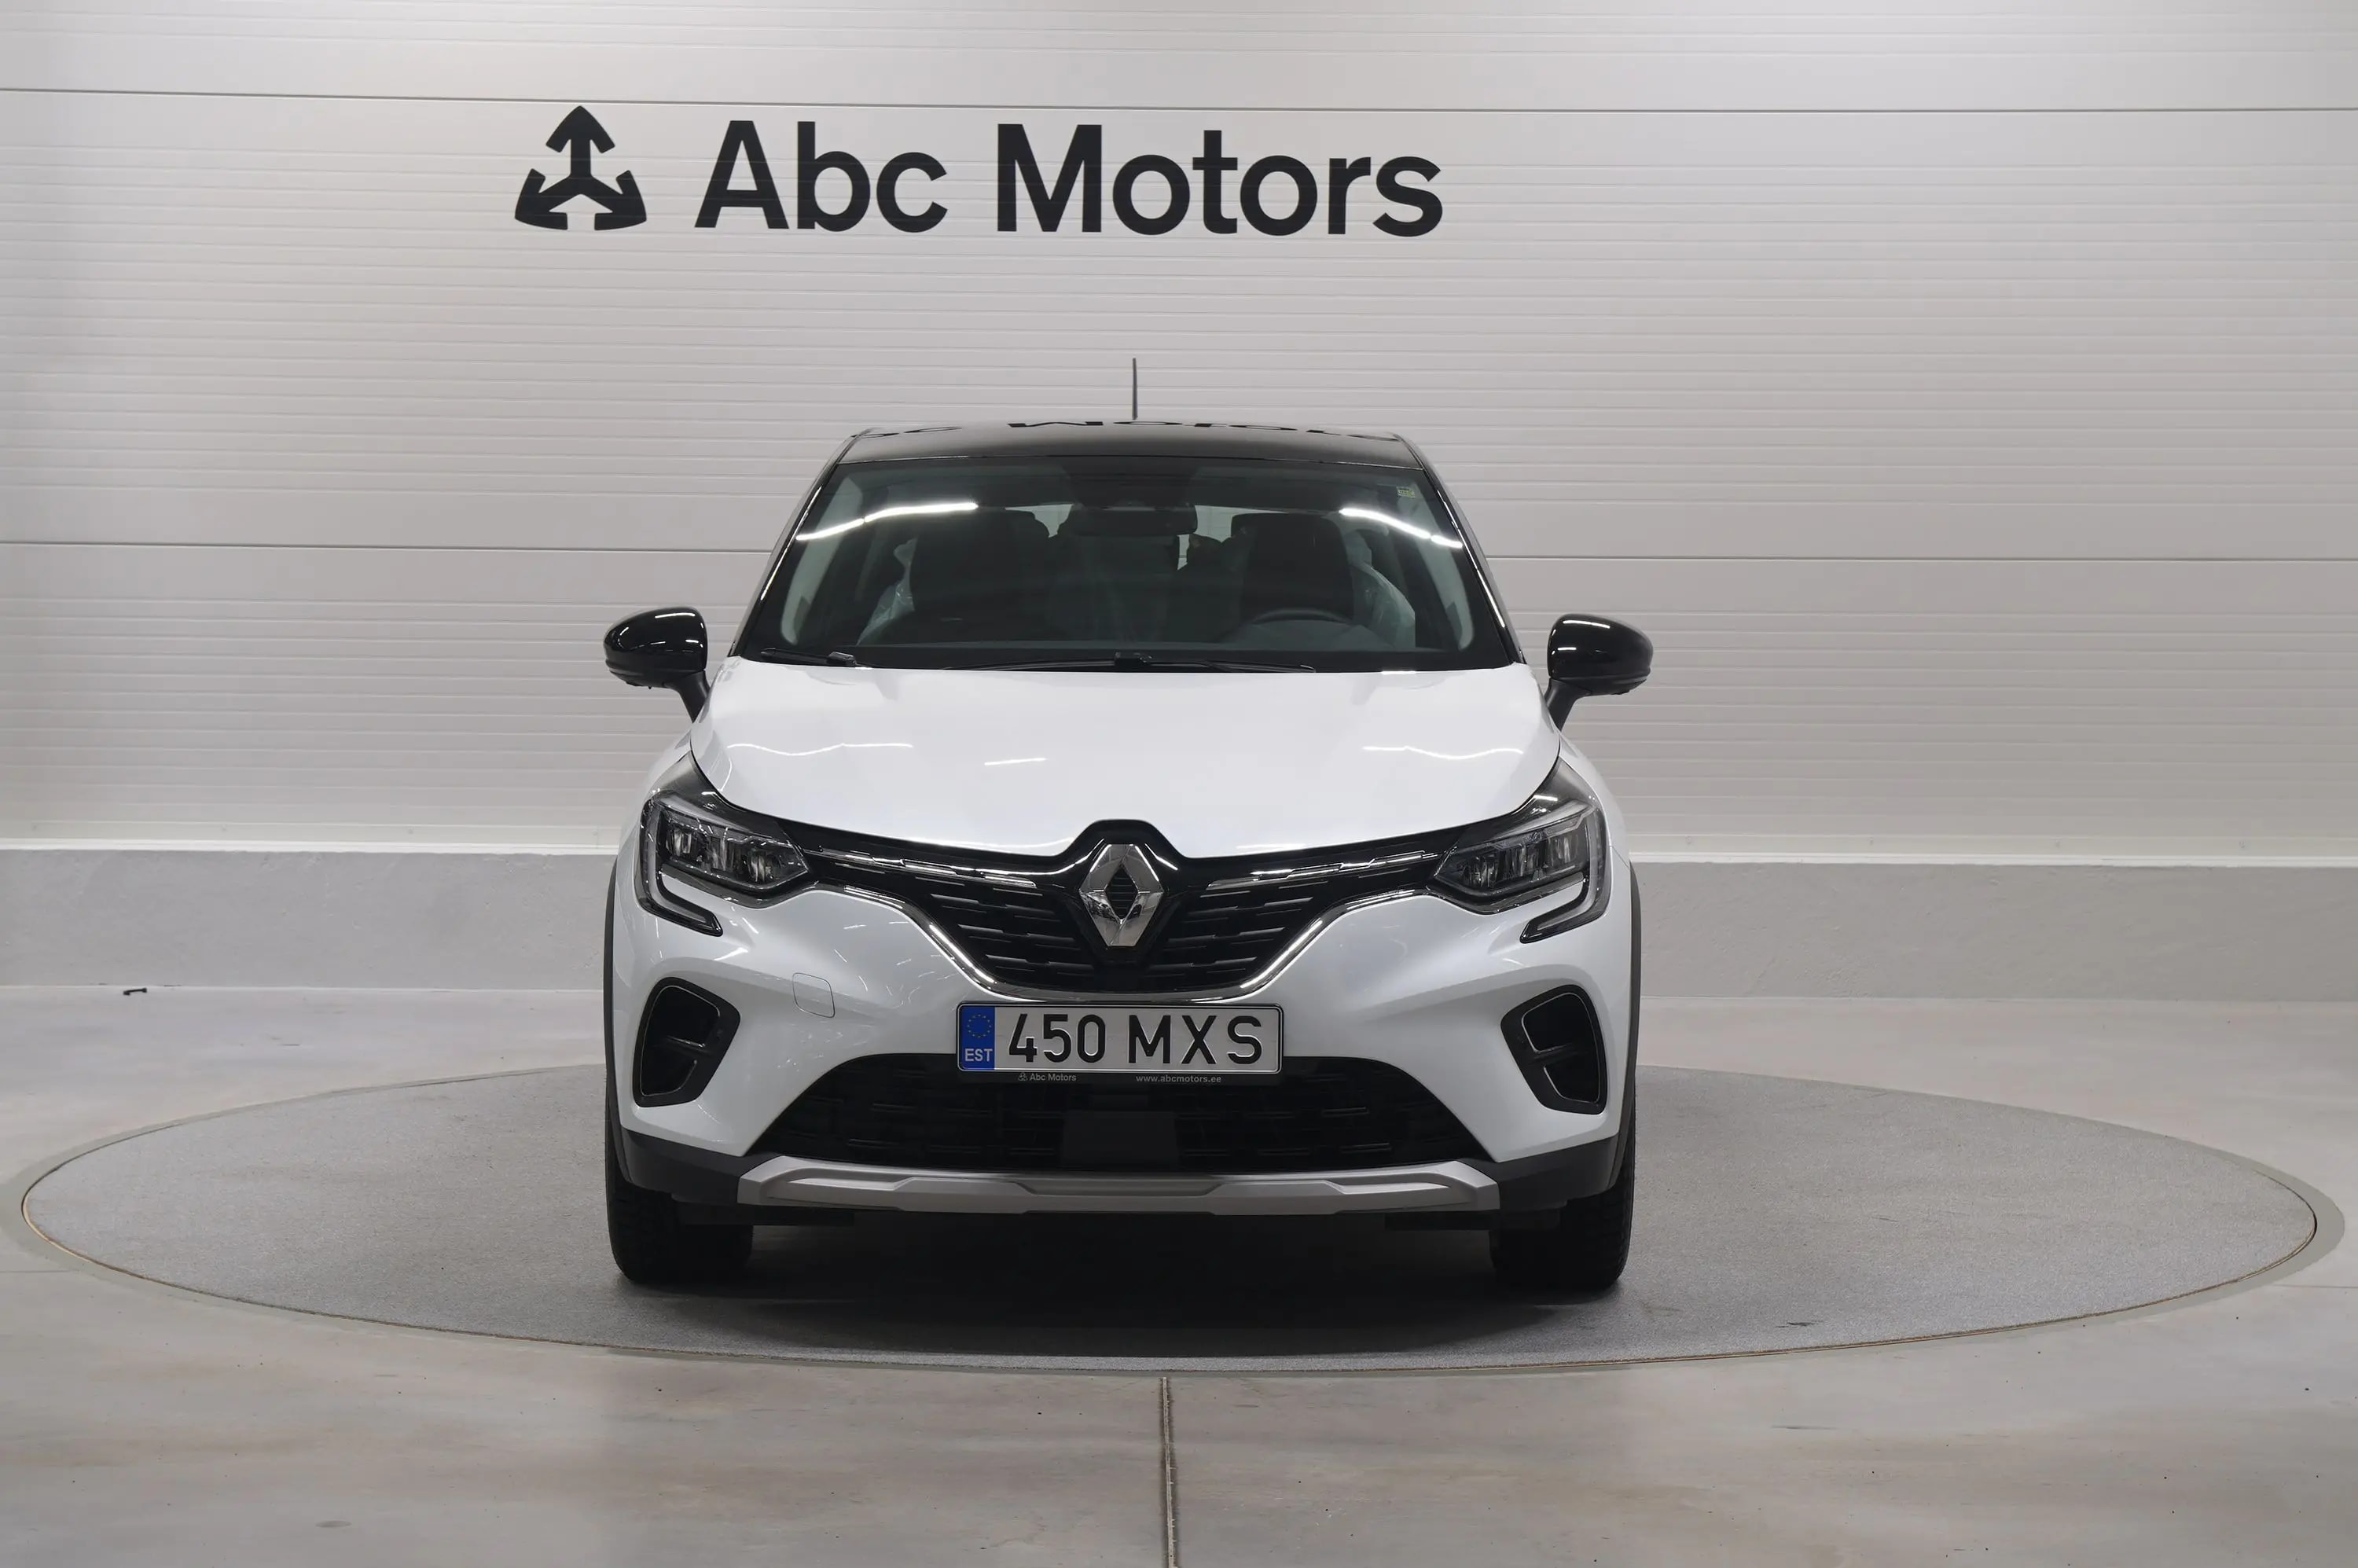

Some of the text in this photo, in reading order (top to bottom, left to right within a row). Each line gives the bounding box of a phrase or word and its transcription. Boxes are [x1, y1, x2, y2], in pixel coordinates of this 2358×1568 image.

[695, 121, 1443, 237] Abc Motors
[1008, 1014, 1262, 1064] 450 MXS
[964, 1048, 993, 1062] EST
[1030, 1073, 1077, 1081] Abc Motors
[1136, 1074, 1221, 1083] www.abcmotors.ee
